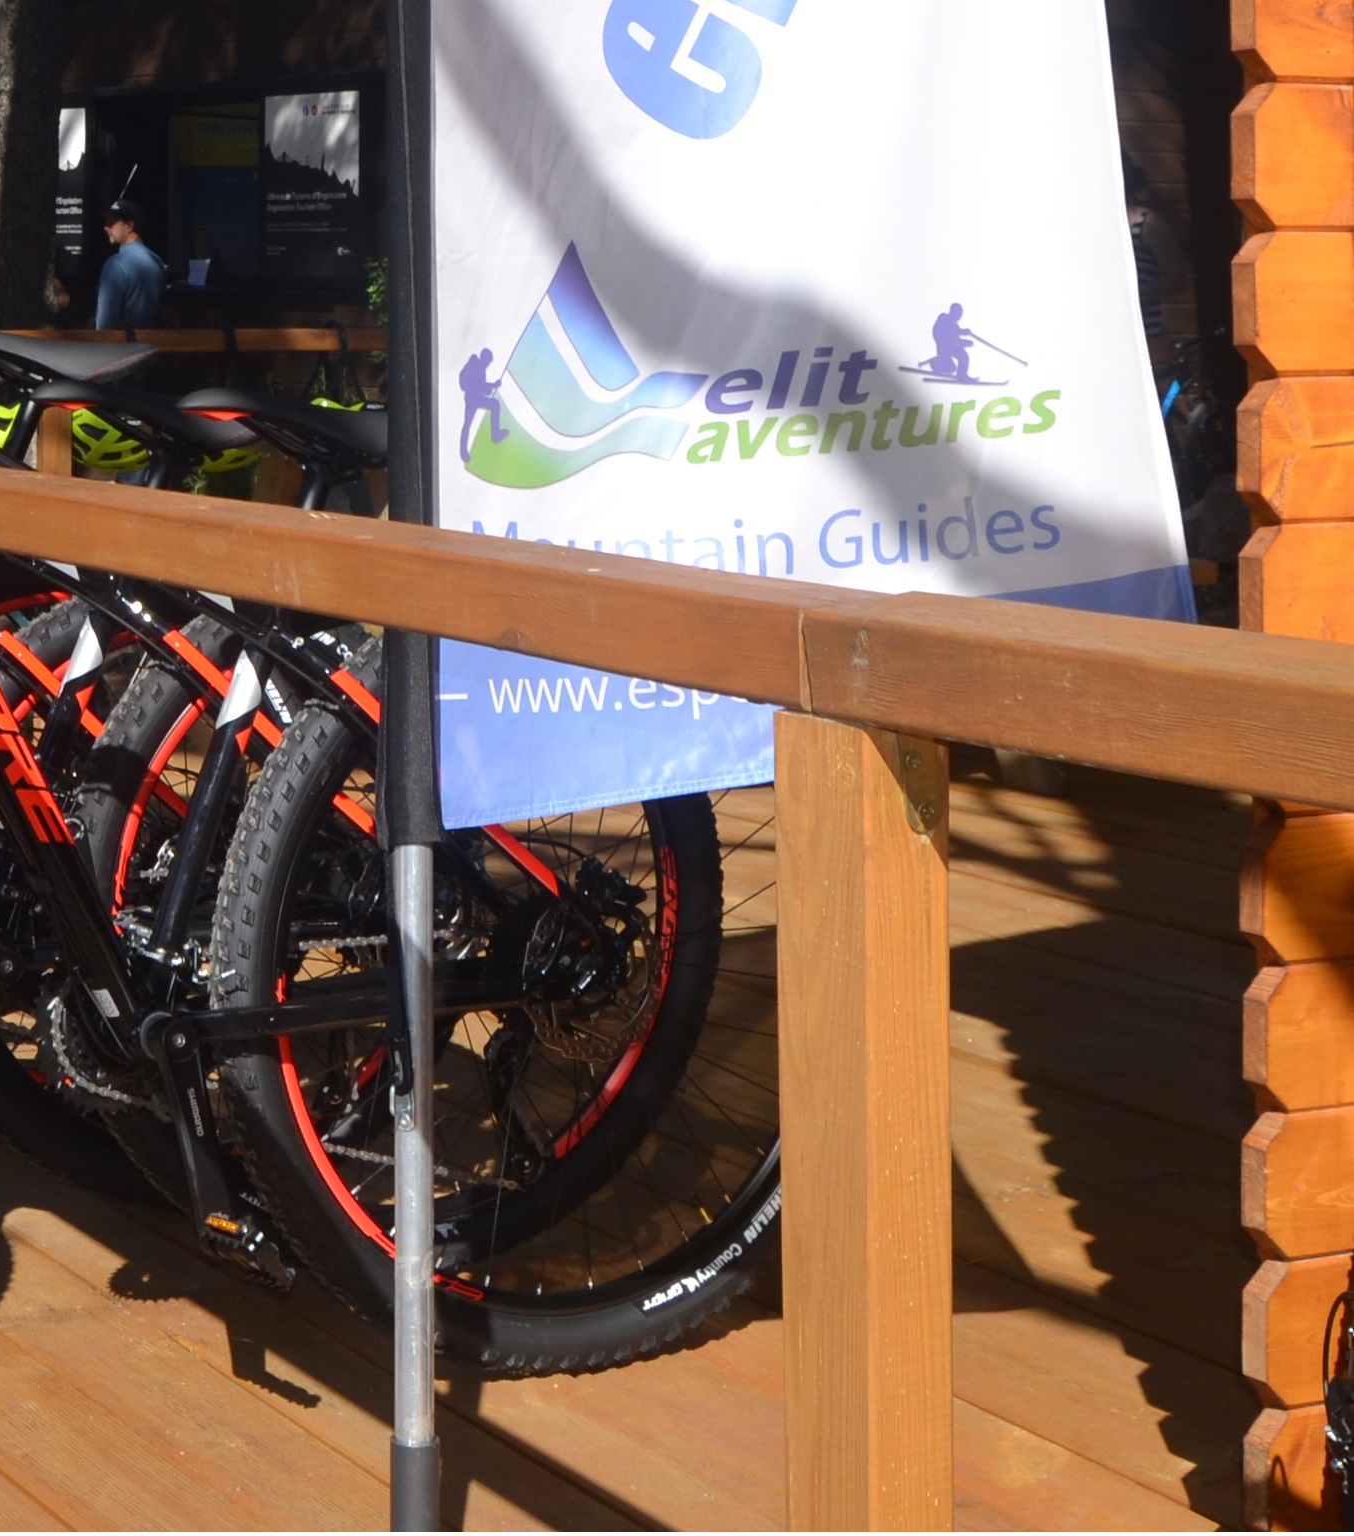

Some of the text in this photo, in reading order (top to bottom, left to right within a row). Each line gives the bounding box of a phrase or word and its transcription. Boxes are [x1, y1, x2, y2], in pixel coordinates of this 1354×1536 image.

[704, 346, 878, 415] elit
[686, 389, 1062, 465] aventures
[818, 496, 1062, 570] Guides
[186, 1087, 205, 1138] SHIMANO
[695, 1242, 744, 1285] Country
